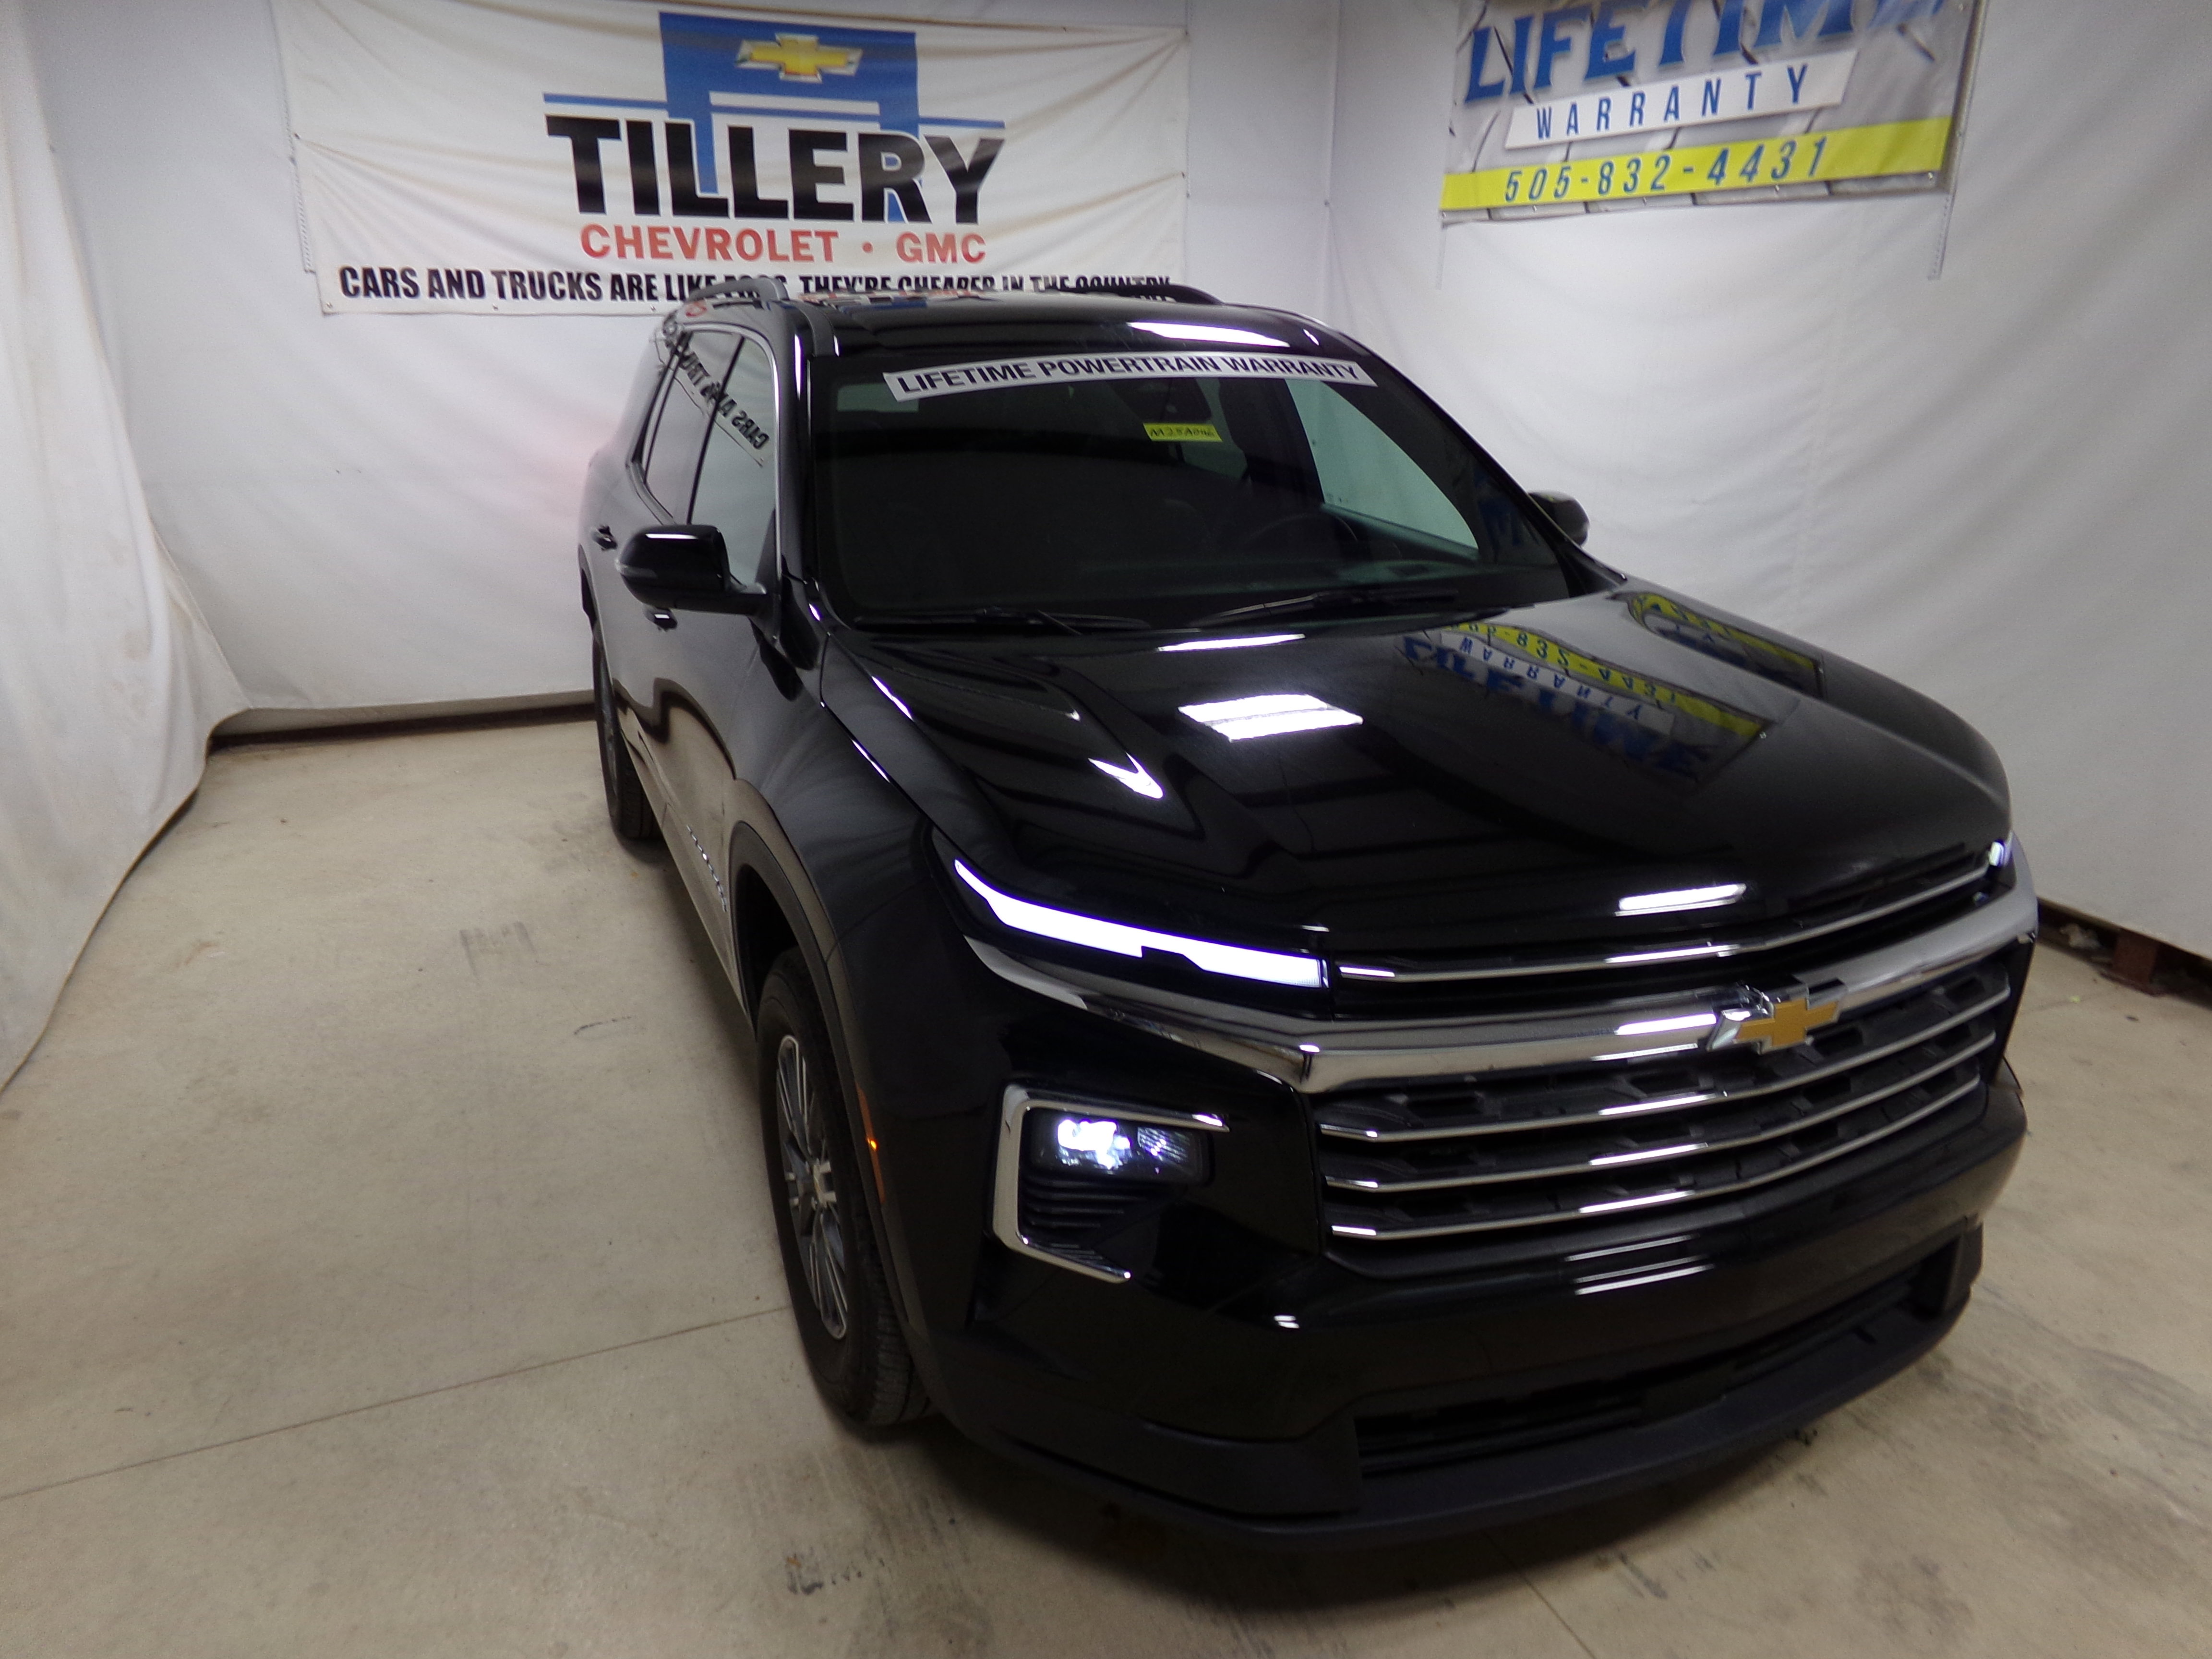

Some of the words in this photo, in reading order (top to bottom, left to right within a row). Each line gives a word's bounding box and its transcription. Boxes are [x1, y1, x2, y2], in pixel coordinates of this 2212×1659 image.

[1536, 64, 1807, 139] WARRANTY
[546, 115, 1005, 224] TILLERY
[1505, 136, 1827, 202] 505-832-4431
[580, 224, 839, 263] CHEVROLET
[896, 232, 986, 264] GMC
[339, 266, 420, 299] CARS
[427, 268, 486, 299] AND
[492, 270, 603, 301] TRUCKS
[610, 273, 659, 301] ARE
[897, 362, 1036, 393] LIFETIME
[1037, 355, 1222, 377] POWERTRAIN
[1221, 357, 1359, 380] WARRANTY
